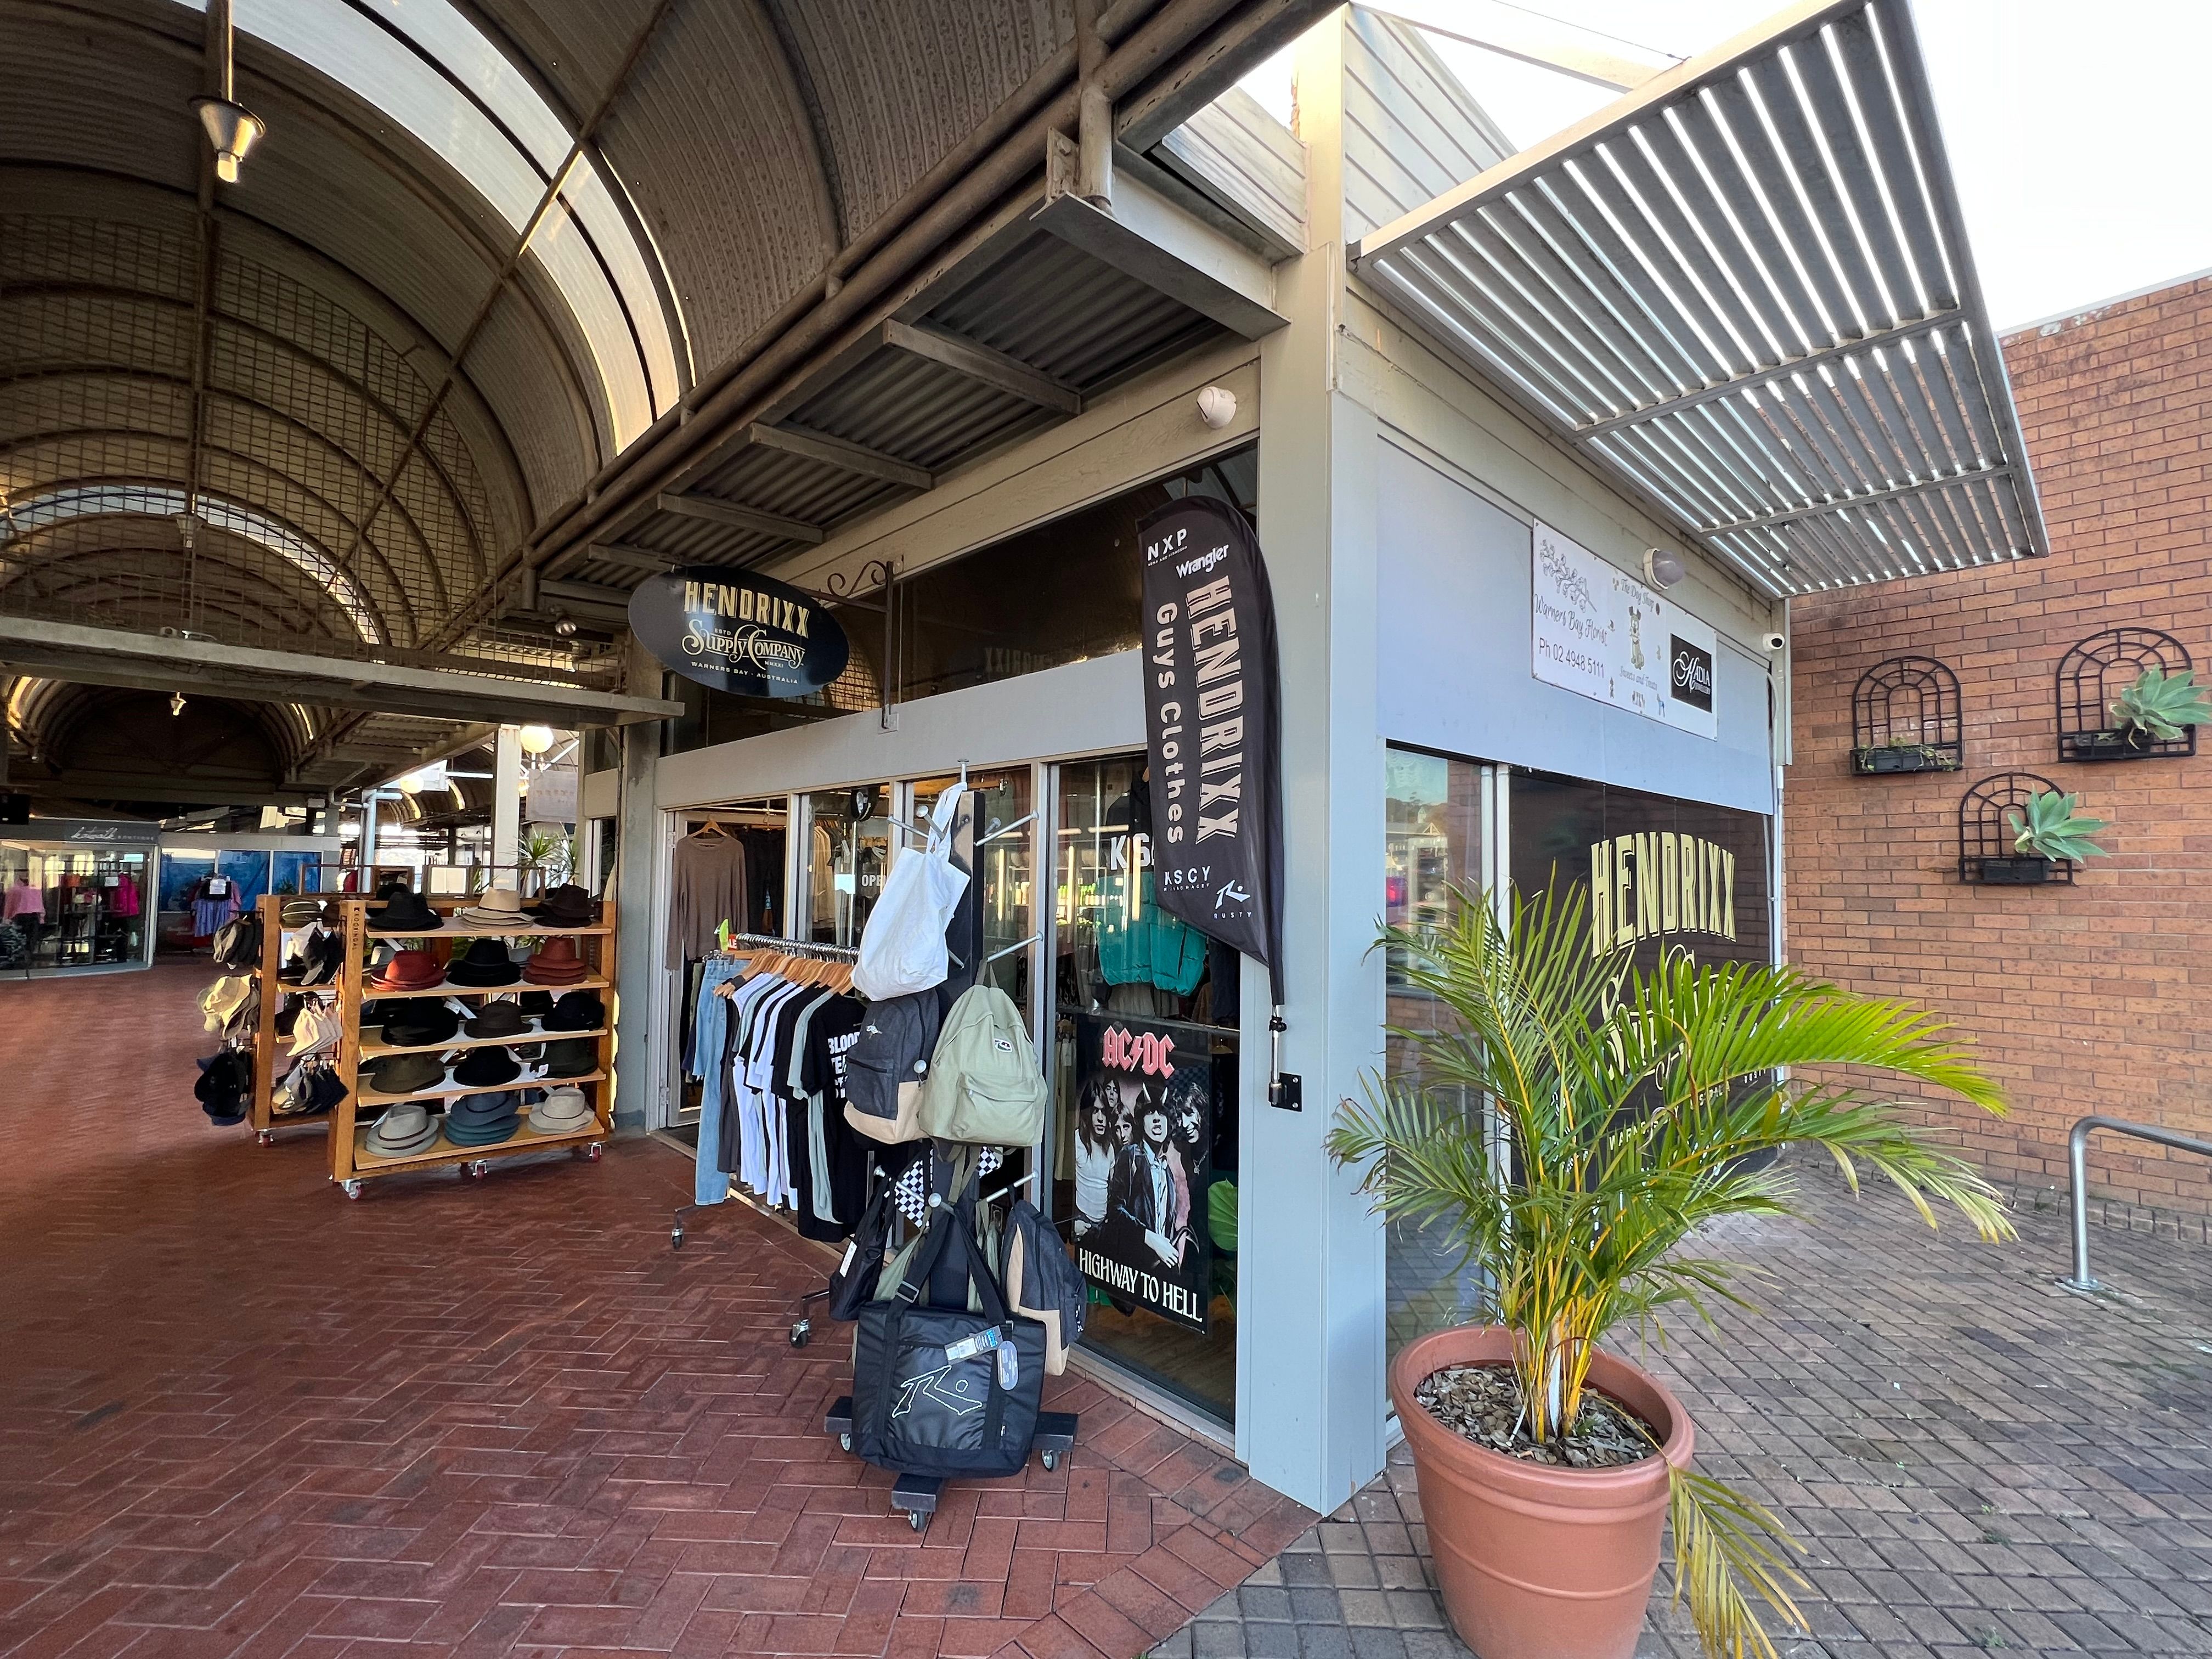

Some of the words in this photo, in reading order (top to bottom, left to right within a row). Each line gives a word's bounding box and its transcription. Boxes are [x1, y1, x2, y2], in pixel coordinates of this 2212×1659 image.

[1148, 528, 1187, 561] NXP
[1176, 544, 1229, 579] Wrangler
[684, 581, 810, 639] HENDRIXX
[1631, 585, 1642, 605] Dog
[714, 628, 731, 636] ESTD
[1534, 594, 1566, 627] Warners
[1568, 611, 1584, 639] Bay
[1585, 619, 1608, 647] Florist
[1153, 602, 1178, 689] Guys
[1539, 637, 1551, 658] Ph
[1553, 644, 1564, 663] 02
[1566, 650, 1586, 671] 4948
[1588, 658, 1605, 679] 5111
[691, 661, 731, 673] WARNERS
[757, 673, 798, 684] AUSTRALIA
[1186, 575, 1244, 845] HENDRIXX
[1160, 701, 1186, 844] Clothes
[861, 874, 886, 887] OPE
[1164, 866, 1211, 885] KSCY
[1214, 911, 1252, 919] RUSTY
[1591, 831, 1736, 962] HENDRIXX
[1079, 1247, 1139, 1293] HIGHWAY
[1140, 1272, 1159, 1302] TO
[1163, 1282, 1203, 1323] HELL
